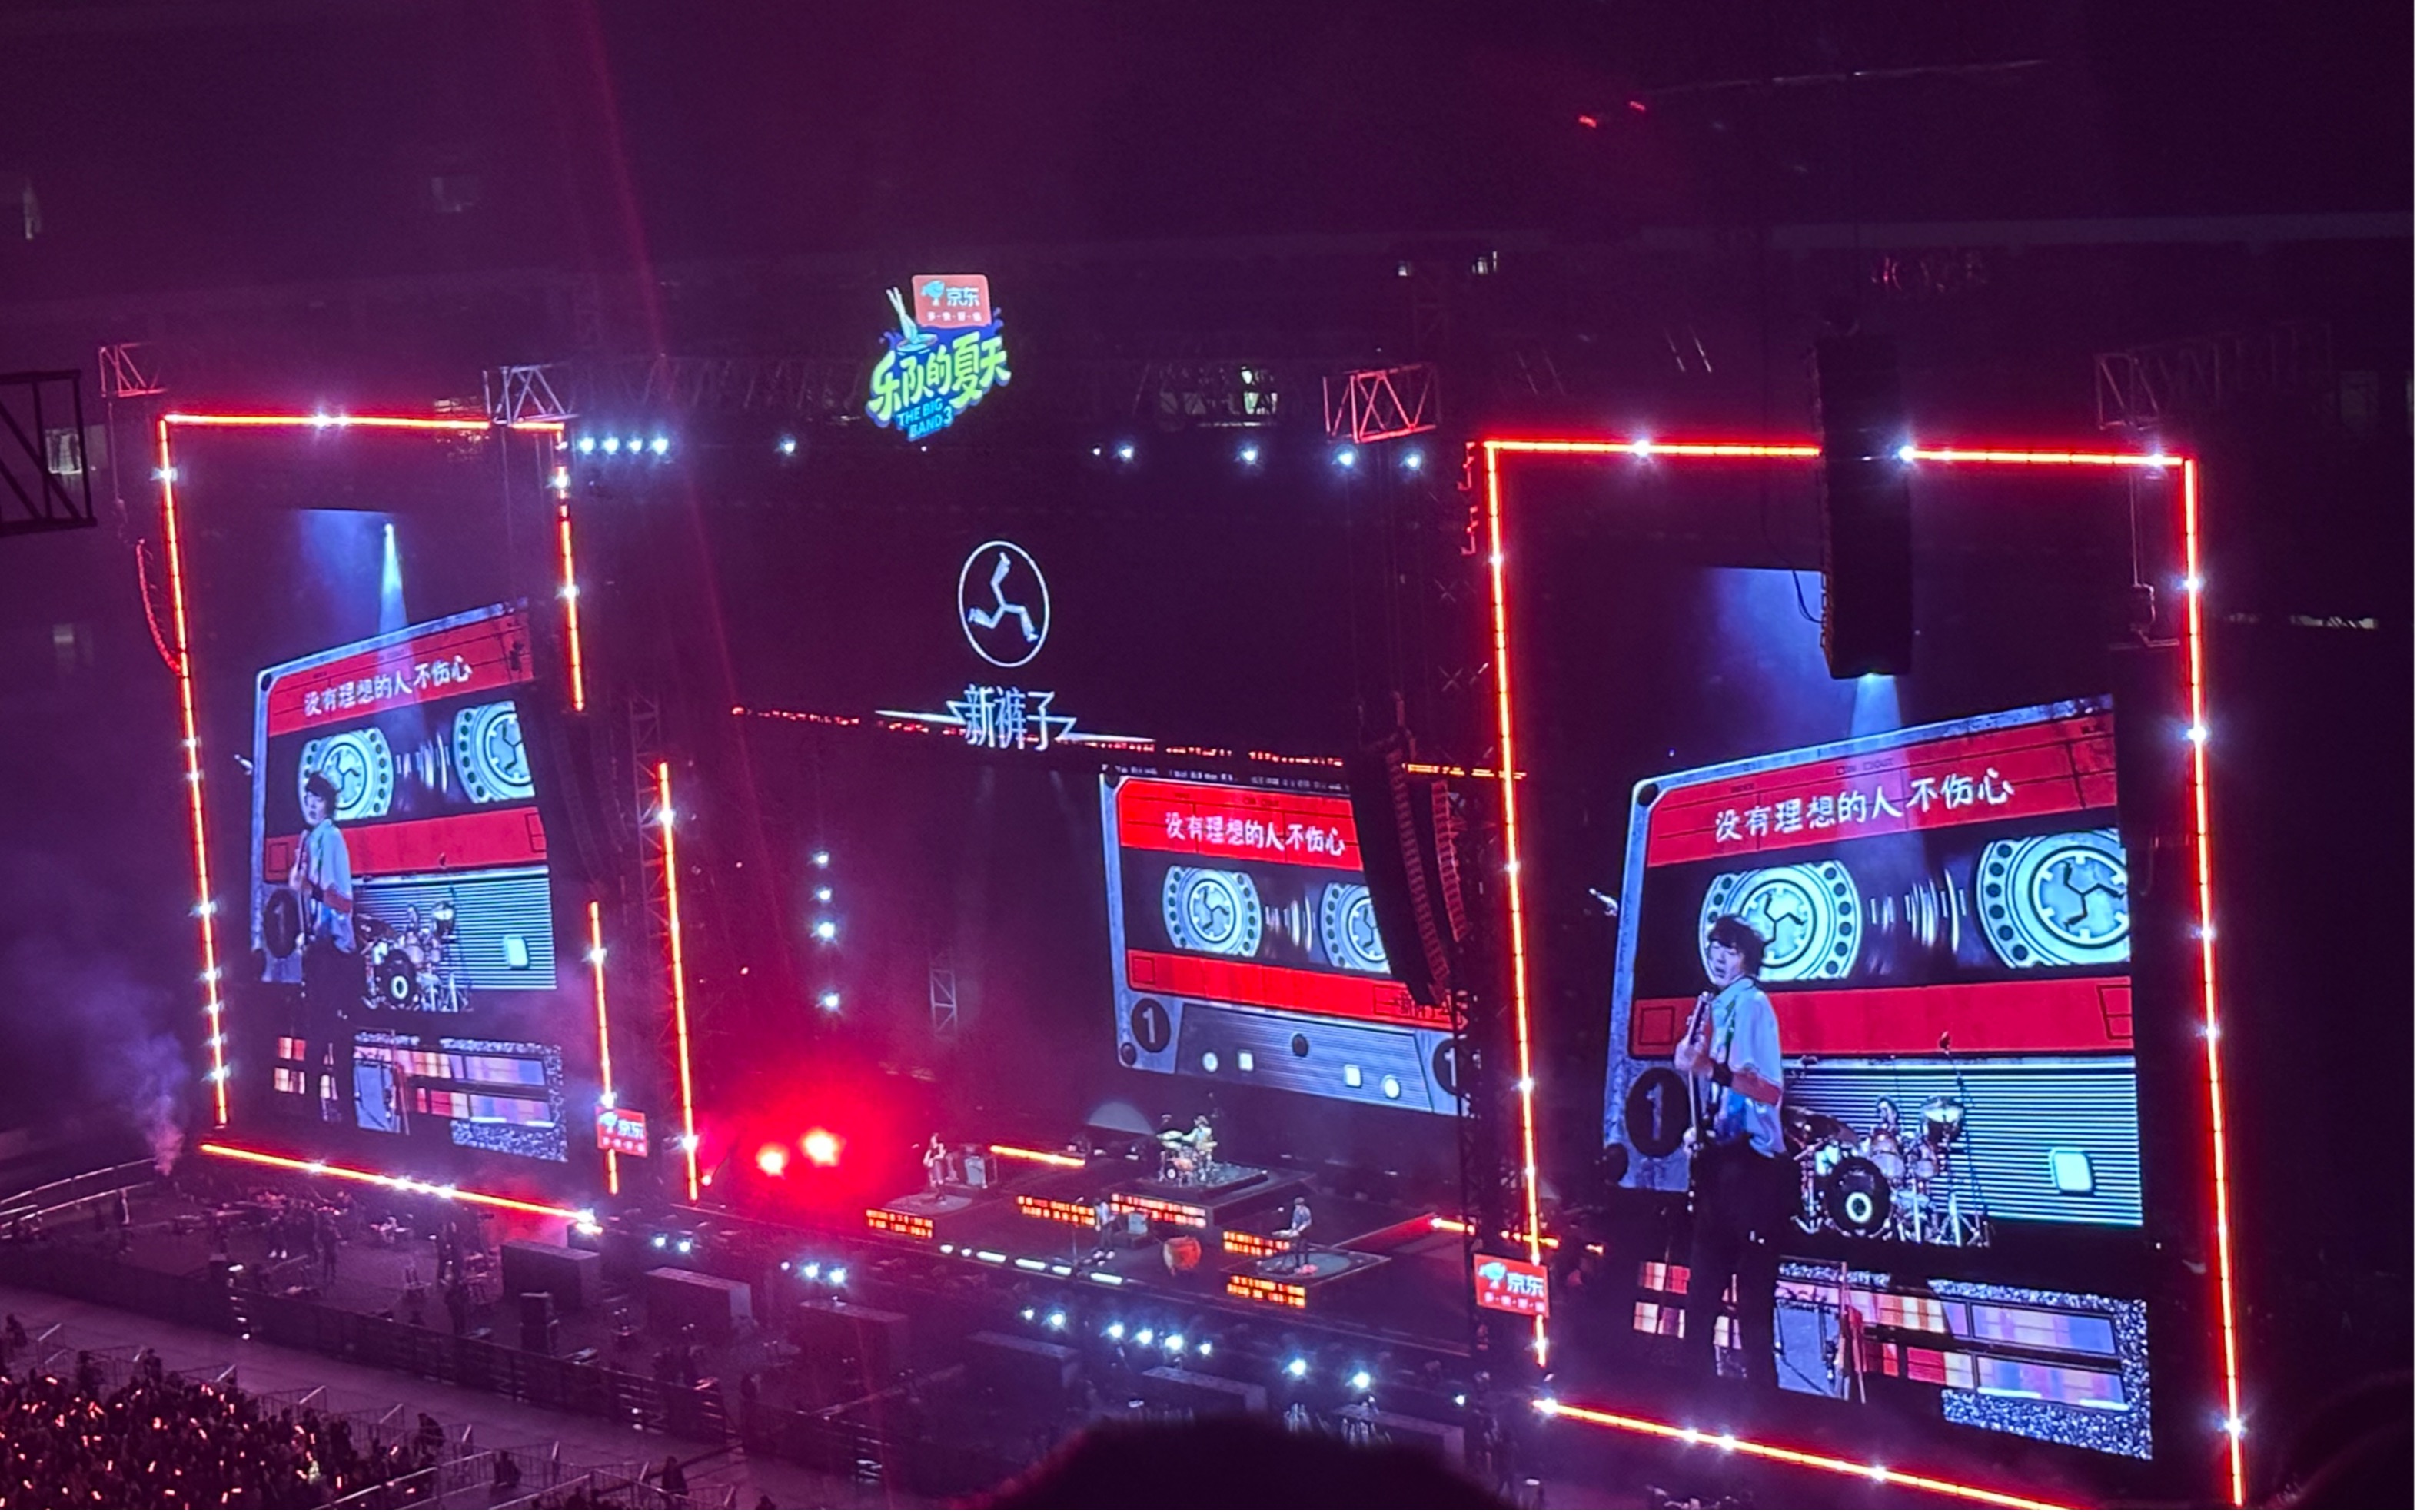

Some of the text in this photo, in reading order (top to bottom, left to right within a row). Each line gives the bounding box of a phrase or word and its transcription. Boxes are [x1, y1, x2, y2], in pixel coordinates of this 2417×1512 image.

[946, 287, 980, 307] 京东
[867, 331, 1012, 421] 乐队的夏天
[896, 397, 943, 427] THE BIG
[909, 405, 953, 438] BAND 3
[304, 655, 474, 716] 没有理想的人不伤心
[1715, 767, 2015, 843] 没有理想的人不伤心
[1165, 812, 1346, 856] 没有理想的人不伤心
[1142, 1007, 1156, 1044] 1
[1443, 1047, 1457, 1088] 1
[617, 1118, 645, 1141] 京东
[1646, 1082, 1664, 1141] 1
[1507, 1272, 1544, 1298] 京东
